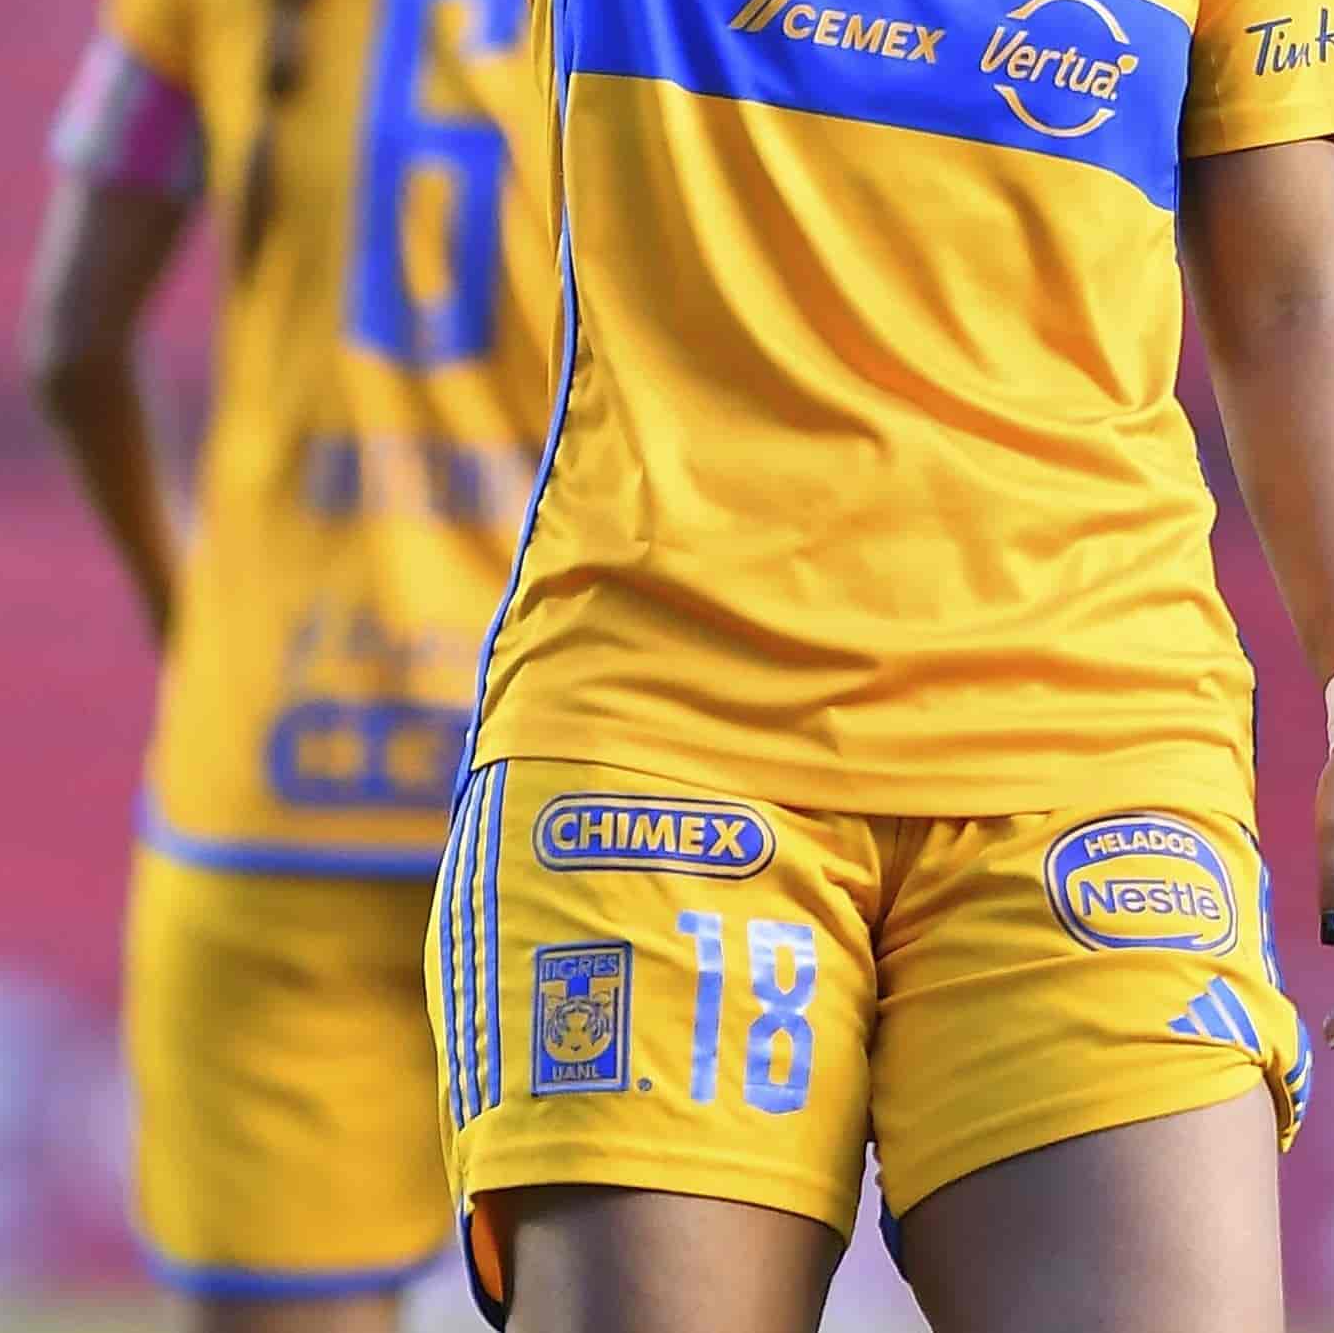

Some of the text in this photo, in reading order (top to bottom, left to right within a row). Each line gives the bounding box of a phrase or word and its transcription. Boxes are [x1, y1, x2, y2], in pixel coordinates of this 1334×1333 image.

[782, 3, 944, 65] CEMEX
[1244, 17, 1311, 77] Tim
[549, 810, 747, 860] CHIMEX
[1083, 830, 1199, 858] HELADOS
[543, 954, 620, 979] TIGRES
[677, 910, 819, 1114] 18
[551, 1065, 601, 1082] UANL
